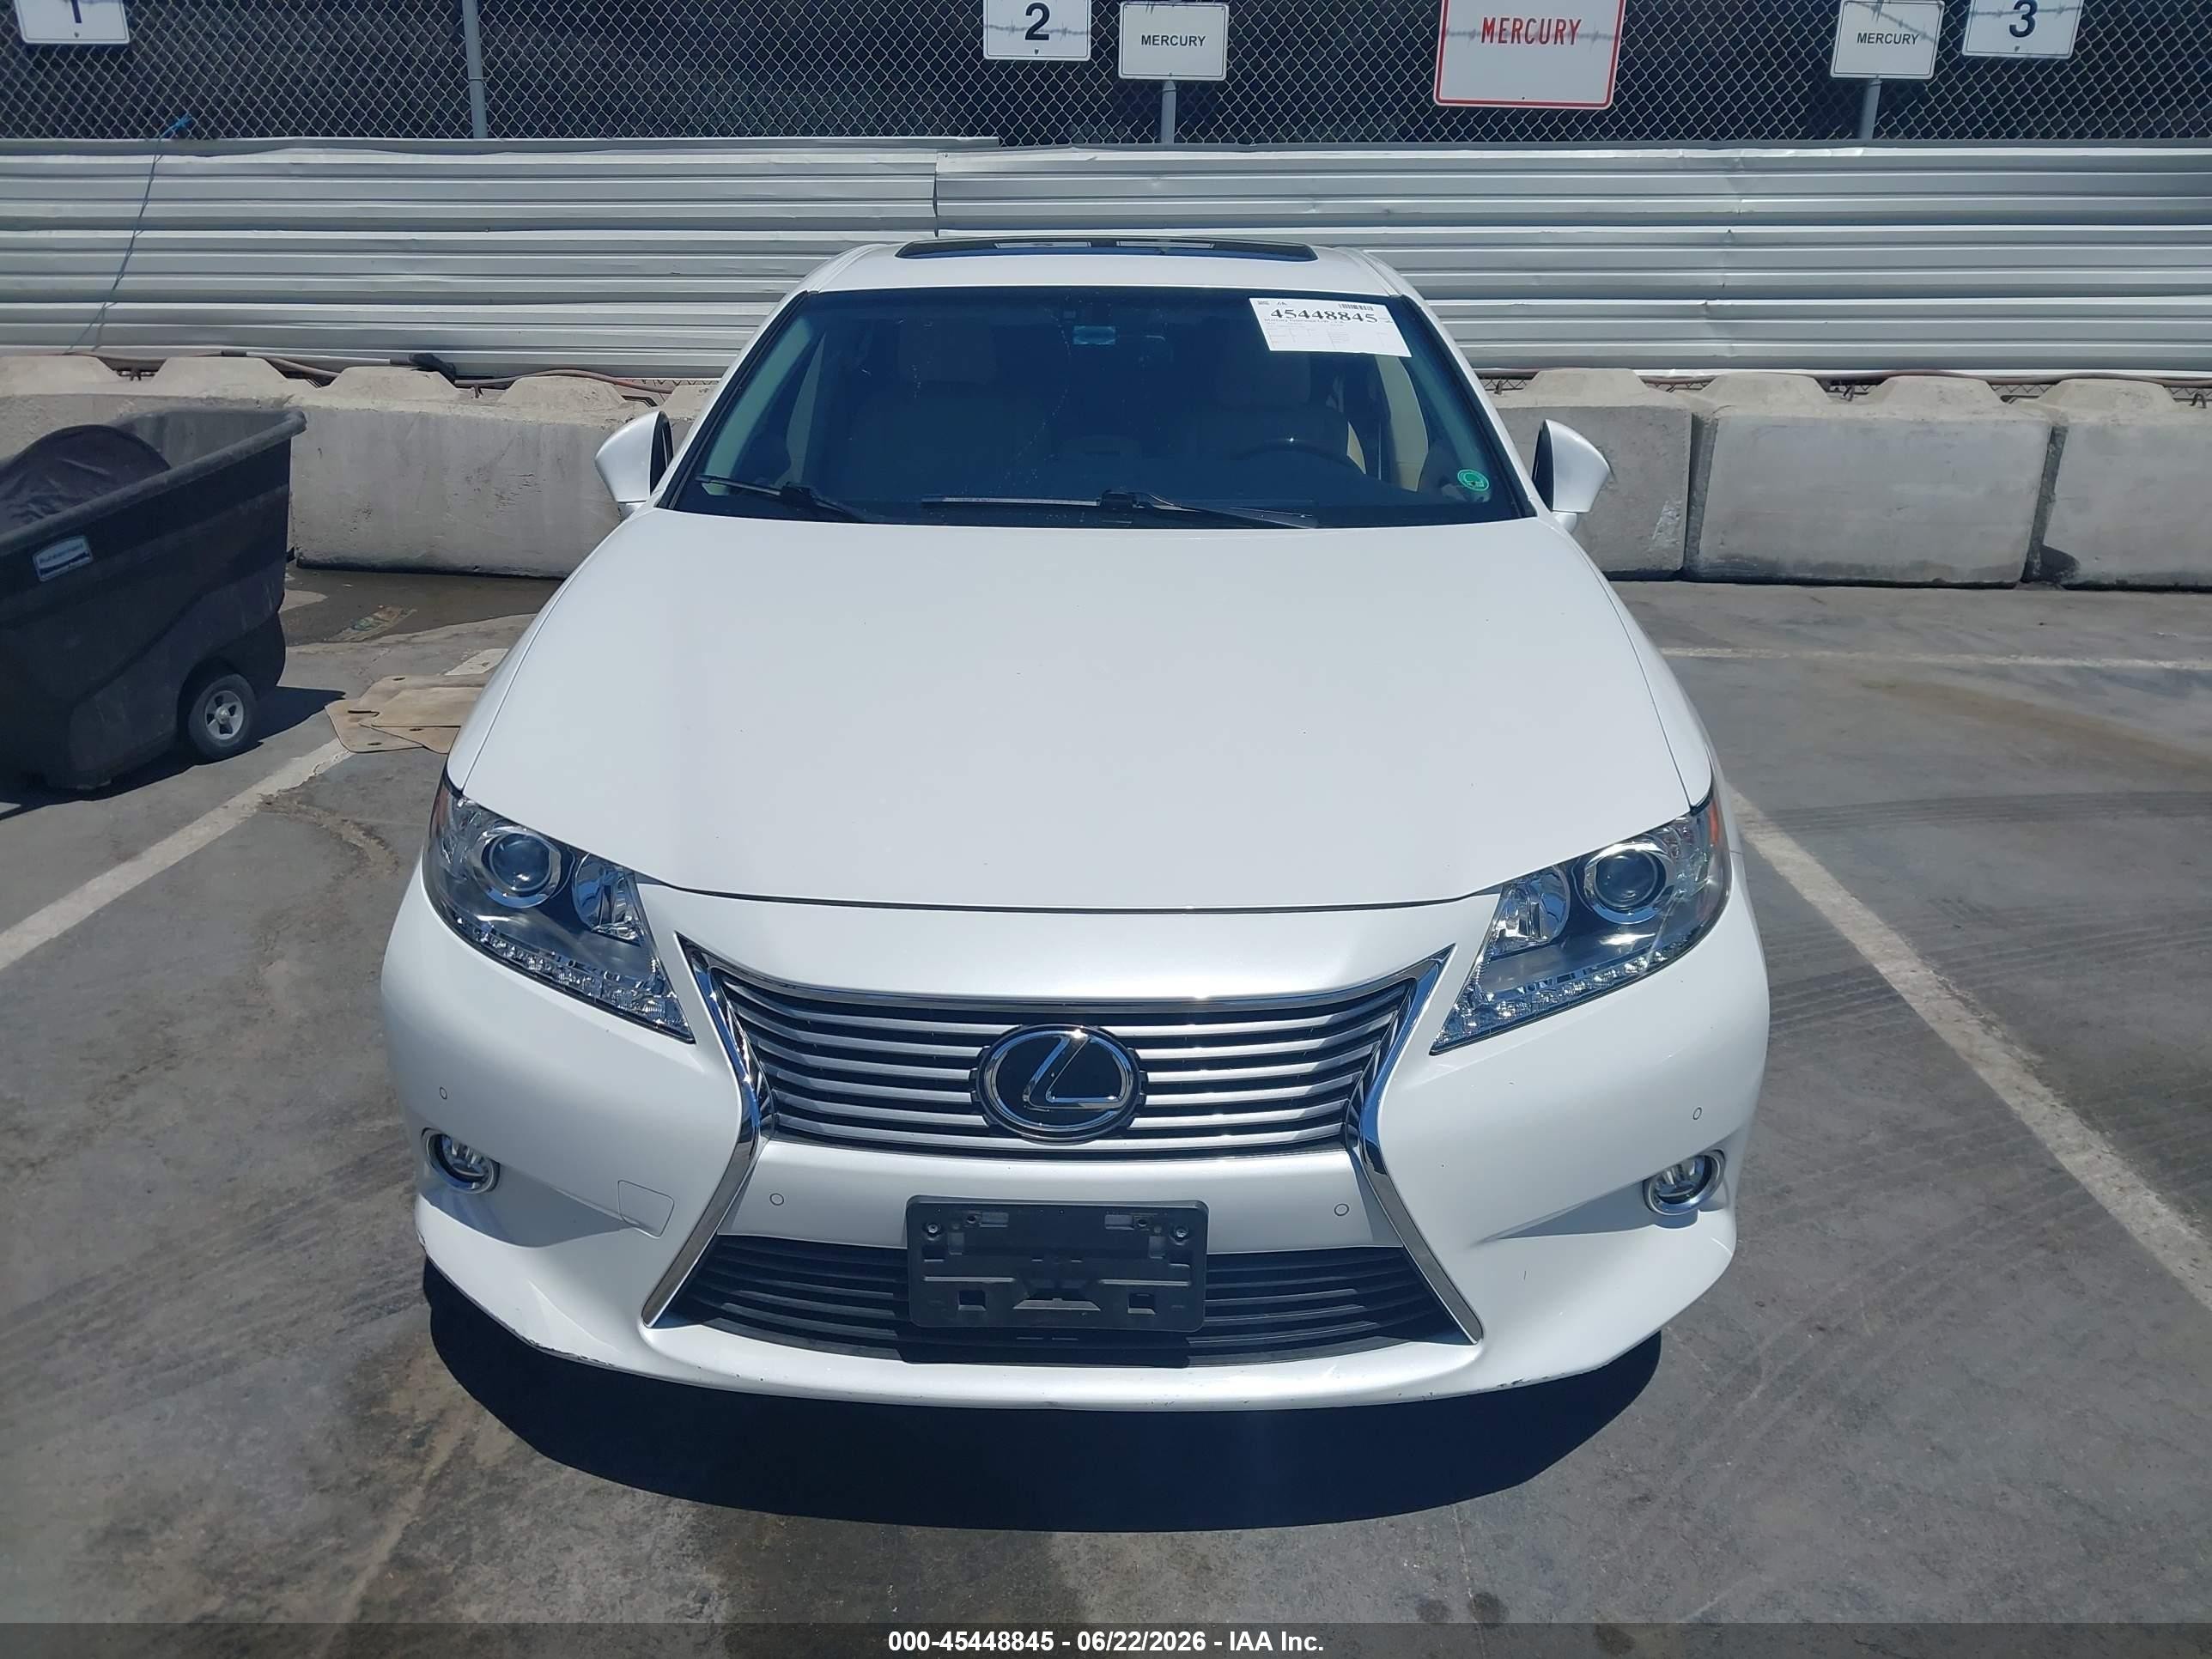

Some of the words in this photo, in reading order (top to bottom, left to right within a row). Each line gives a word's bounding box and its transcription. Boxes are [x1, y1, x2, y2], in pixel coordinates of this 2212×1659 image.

[1024, 2, 1050, 40] 2
[2009, 0, 2038, 38] 3
[1141, 34, 1206, 47] MERCURY
[1480, 17, 1582, 45] MERCURY
[1856, 32, 1919, 46] MERCURY
[1271, 308, 1377, 323] 45448845
